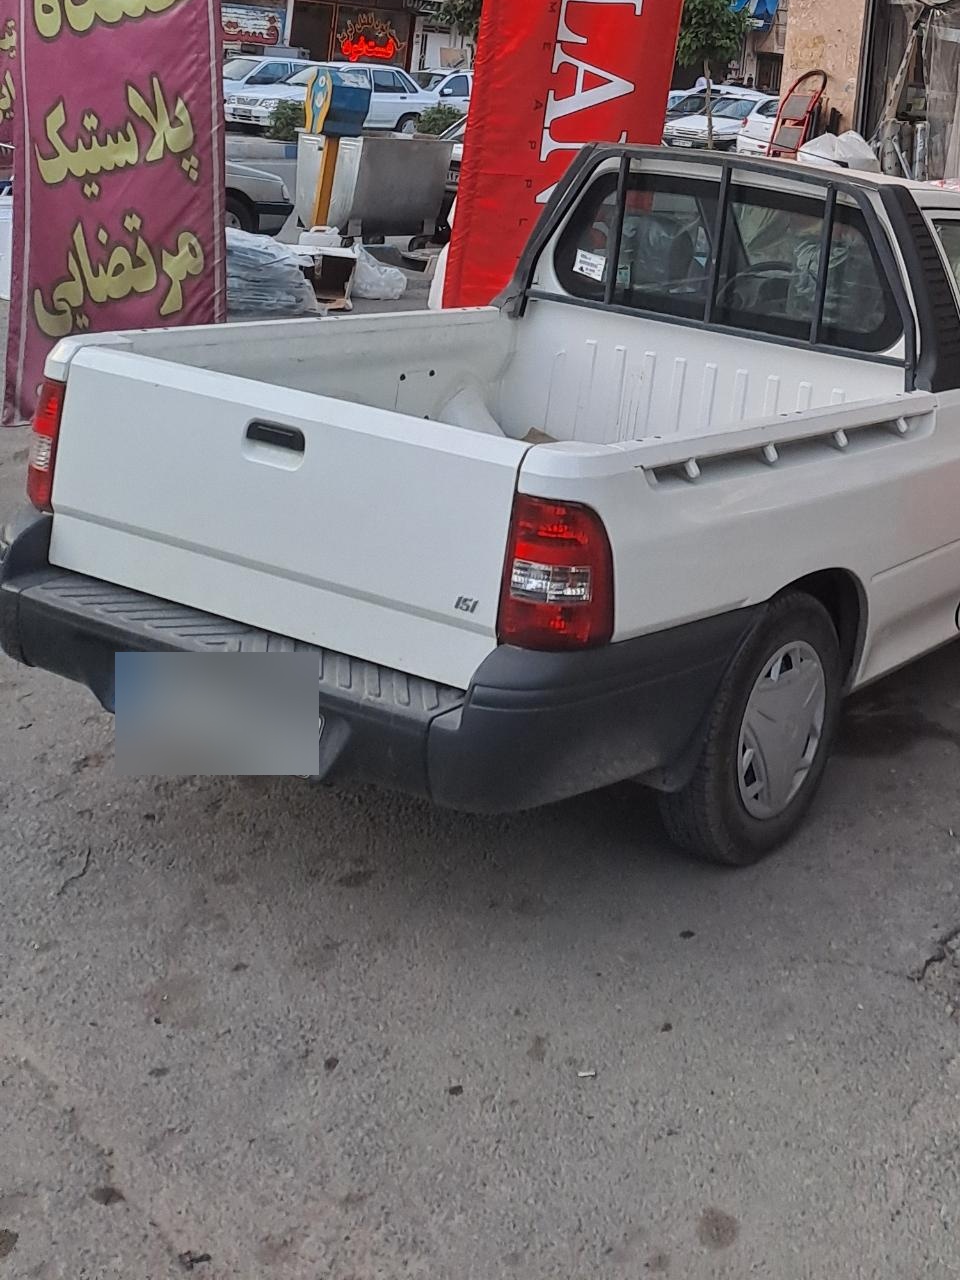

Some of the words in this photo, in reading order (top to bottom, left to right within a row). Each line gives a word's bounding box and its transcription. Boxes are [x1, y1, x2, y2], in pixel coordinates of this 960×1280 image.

[365, 37, 395, 60] فست
[33, 75, 200, 200] پلاستیک
[33, 213, 205, 337] مرتضایی
[454, 596, 479, 613] 151
